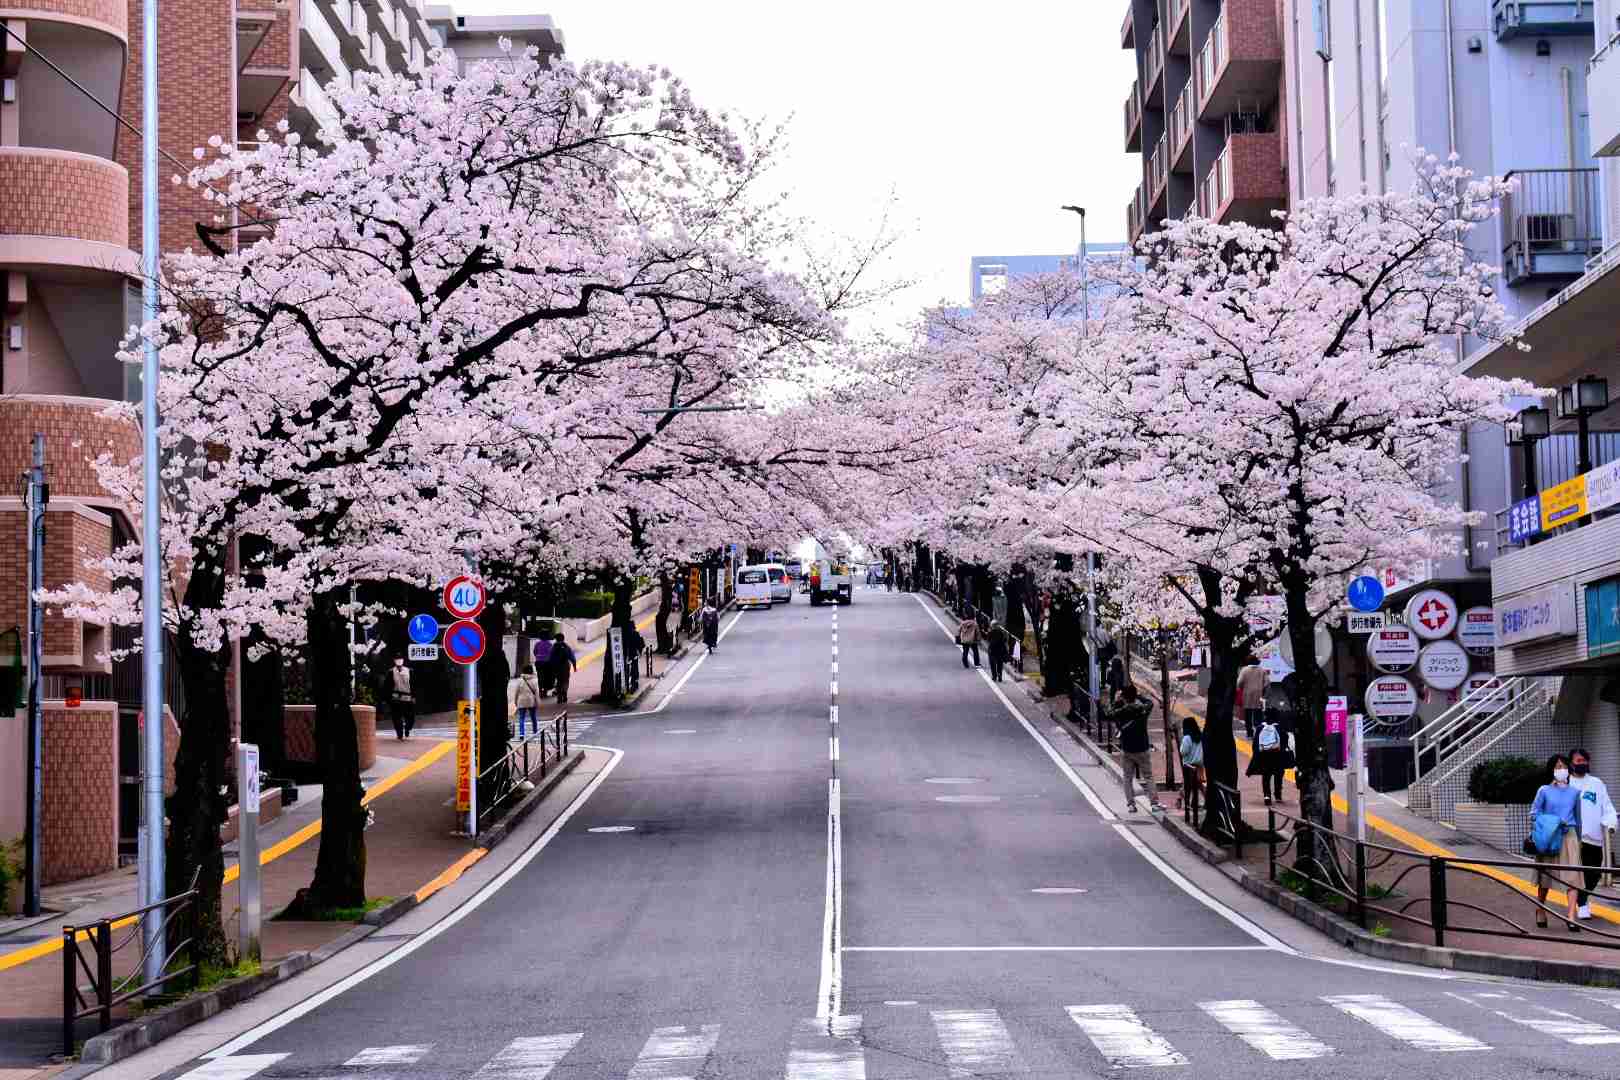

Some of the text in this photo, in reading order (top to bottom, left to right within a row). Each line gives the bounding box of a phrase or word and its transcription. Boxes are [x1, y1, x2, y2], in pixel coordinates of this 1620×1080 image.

[453, 588, 477, 607] 40
[1430, 657, 1458, 665] クリニック
[1427, 665, 1461, 673] ステーション
